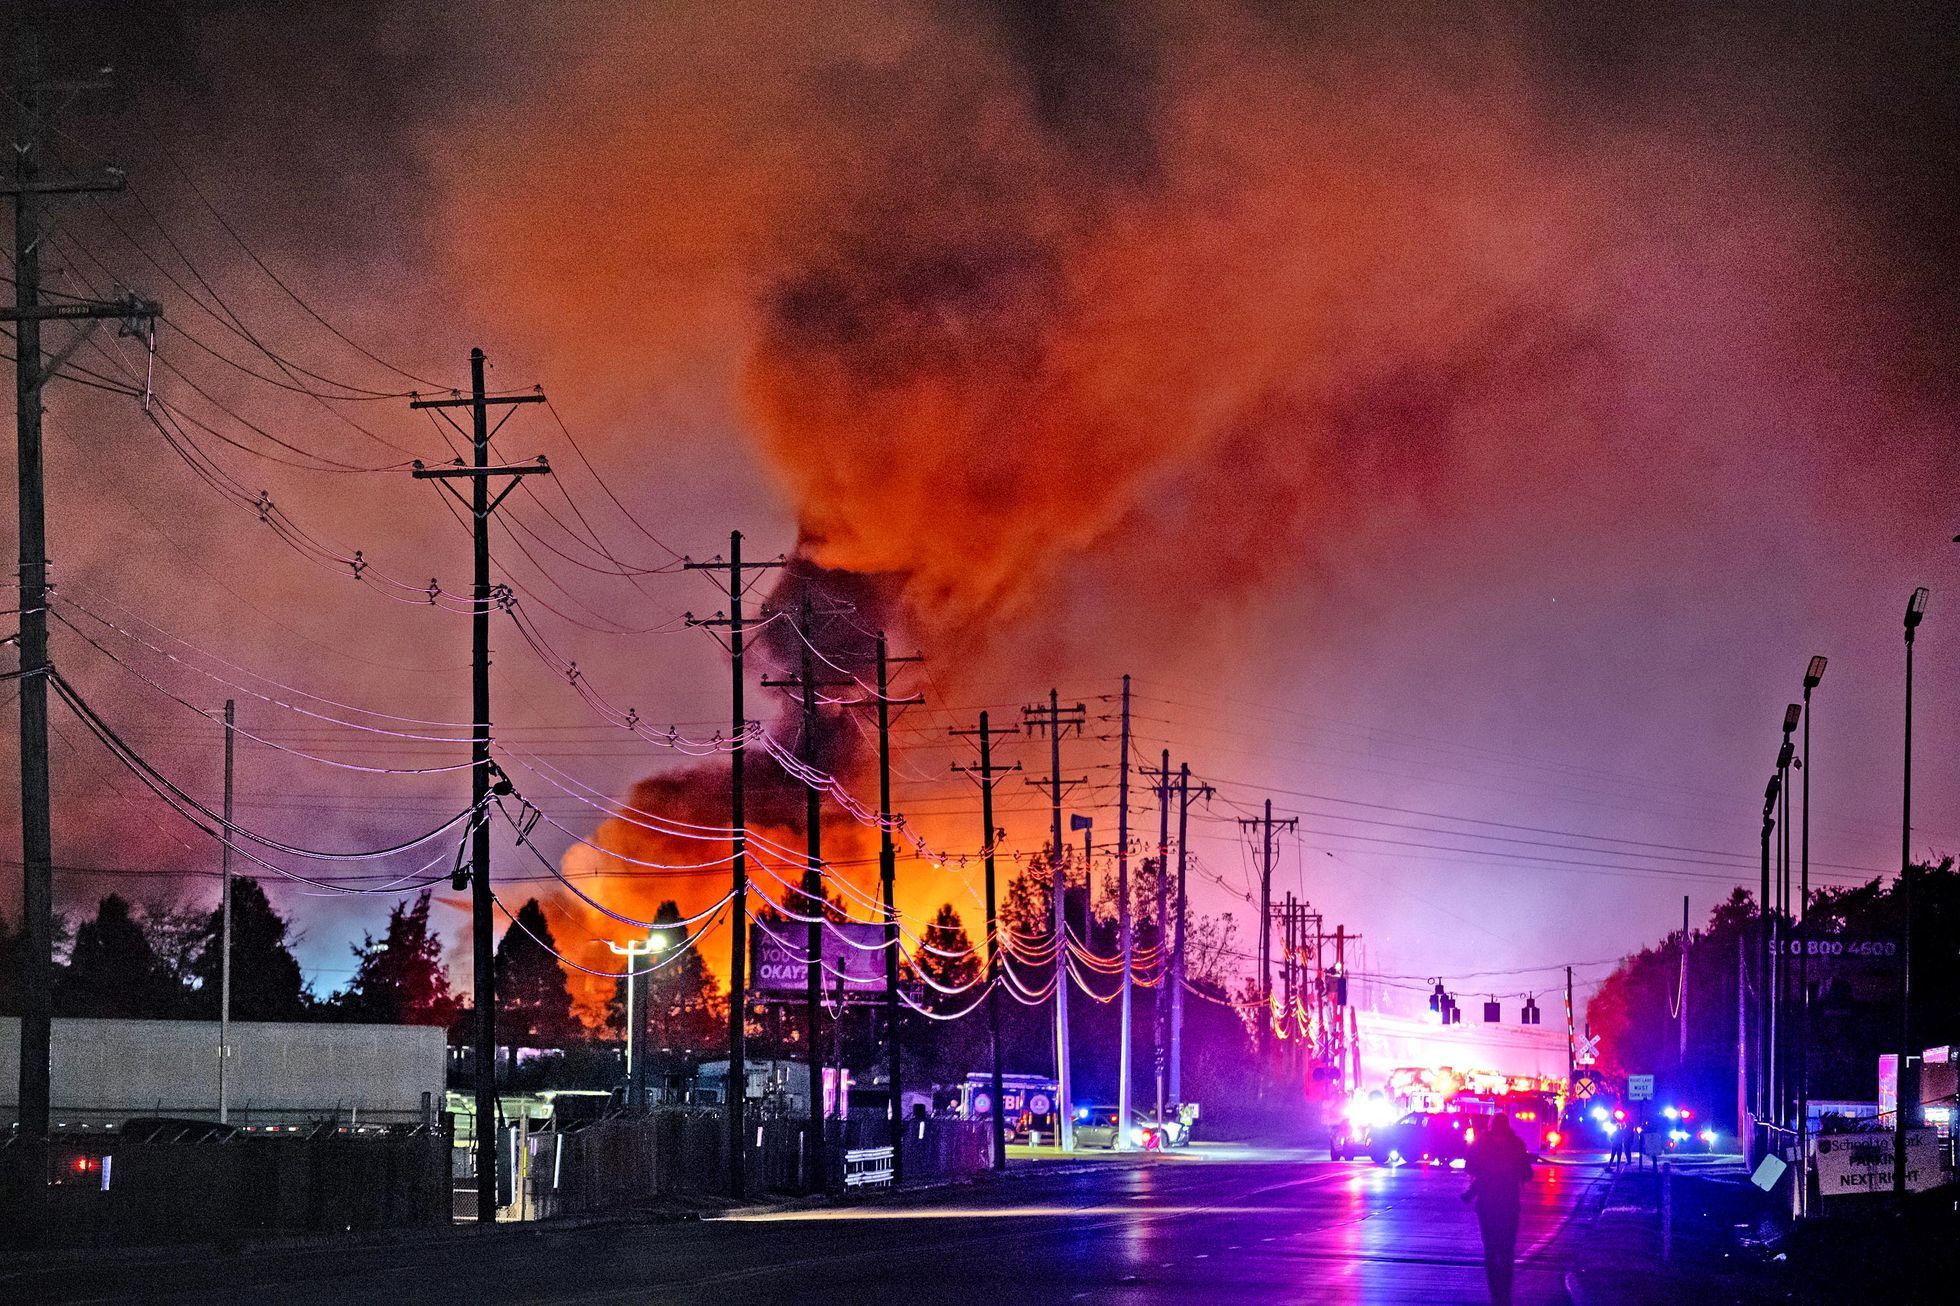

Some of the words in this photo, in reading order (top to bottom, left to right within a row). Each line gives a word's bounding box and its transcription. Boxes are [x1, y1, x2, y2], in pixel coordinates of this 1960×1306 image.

[1807, 940, 1843, 955] 800
[762, 948, 791, 962] YOU
[760, 964, 808, 979] OKAY?
[1892, 1133, 1923, 1147] ork
[1840, 1173, 1876, 1186] NEXT
